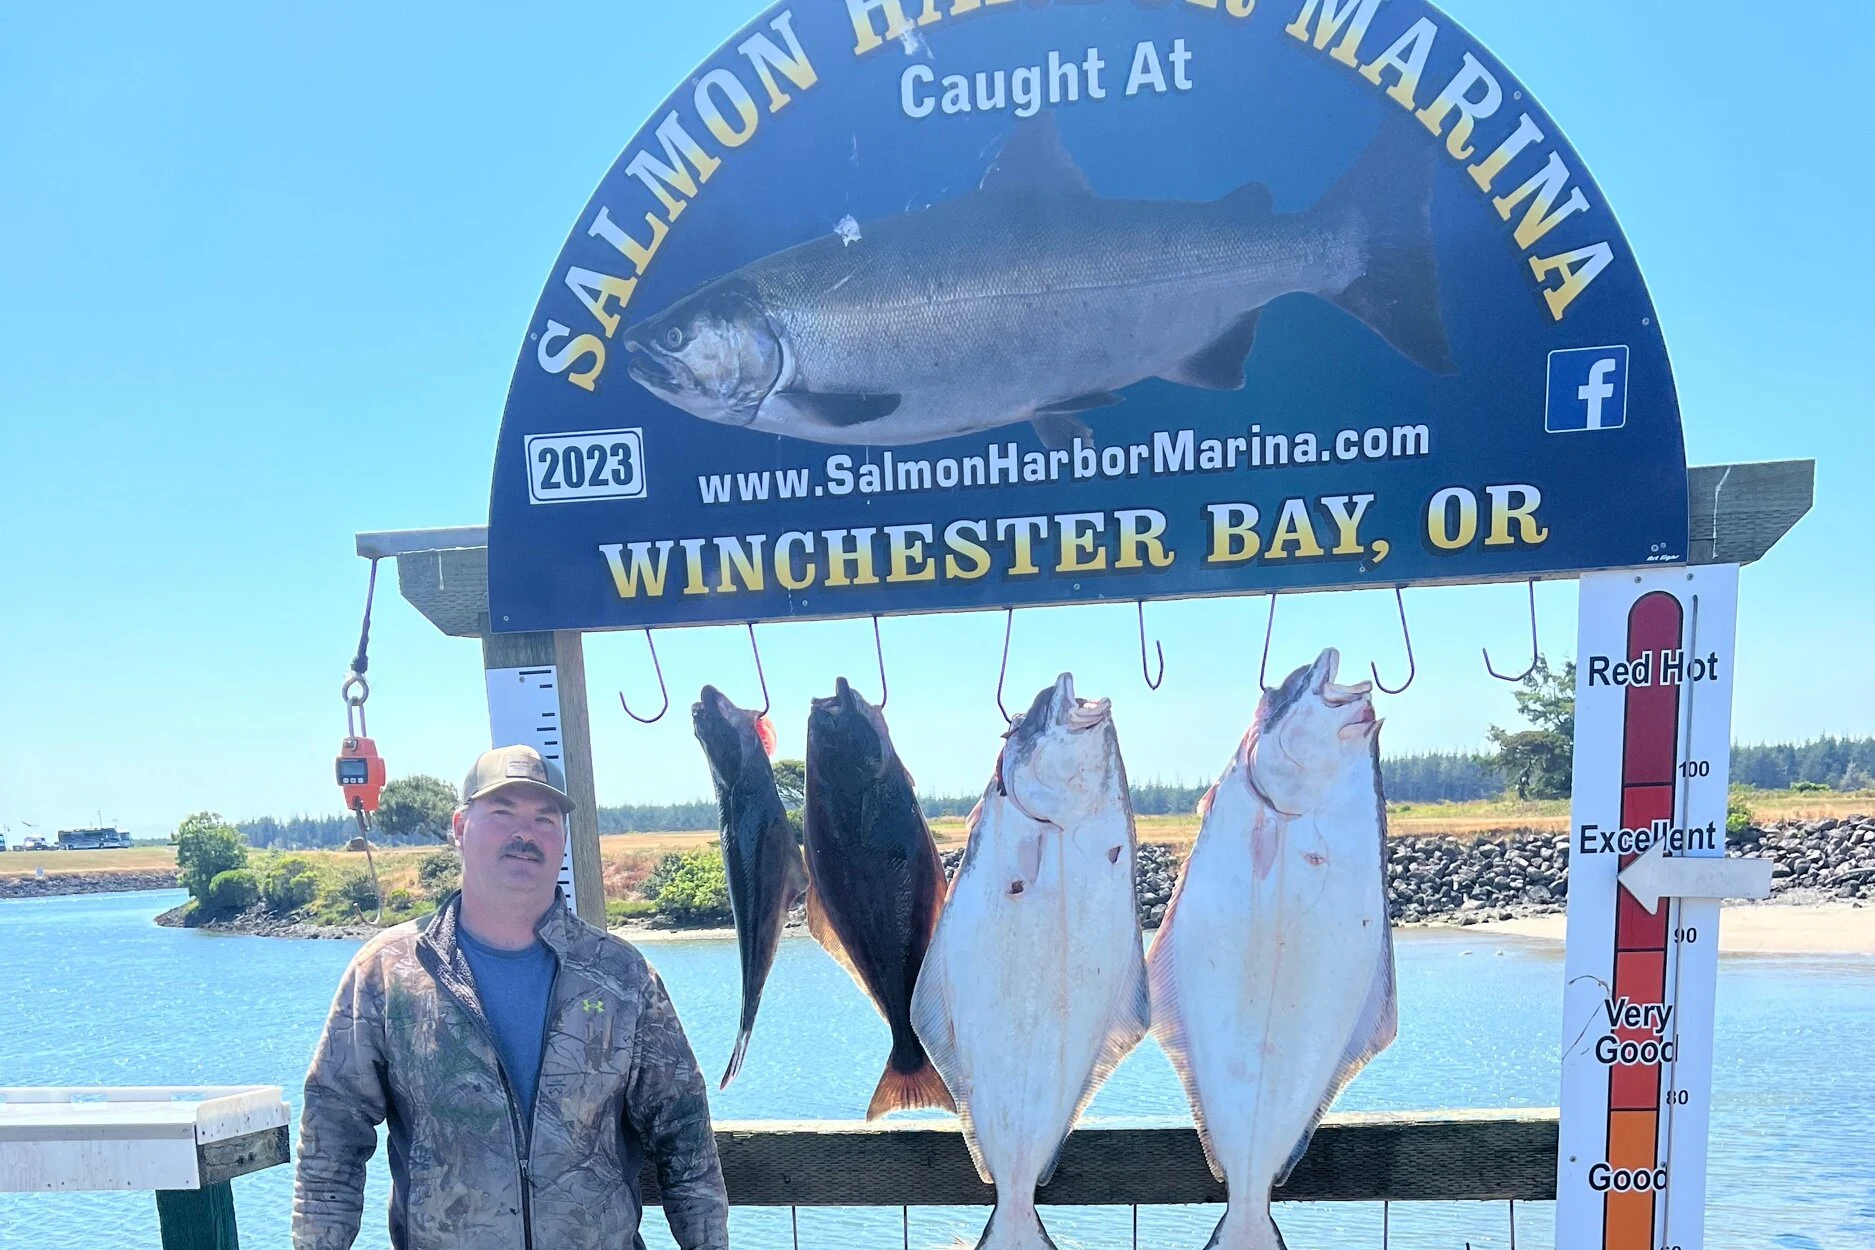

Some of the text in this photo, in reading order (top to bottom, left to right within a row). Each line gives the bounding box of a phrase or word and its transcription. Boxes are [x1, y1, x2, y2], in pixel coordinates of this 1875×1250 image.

[901, 38, 1193, 118] Caught At
[537, 0, 1614, 391] SALMON MARINA
[538, 444, 634, 491] 2023
[698, 423, 1430, 503] www.SalmonHarborMarina.com
[600, 483, 1549, 598] WINCHESTER BAY, OR
[1589, 651, 1718, 687] Red Hot
[1678, 761, 1710, 778] 100
[1580, 821, 1716, 854] Excellent
[1674, 927, 1697, 943] 90
[1604, 999, 1673, 1033] Very
[1595, 1034, 1679, 1064] Good
[1666, 1090, 1689, 1105] 80
